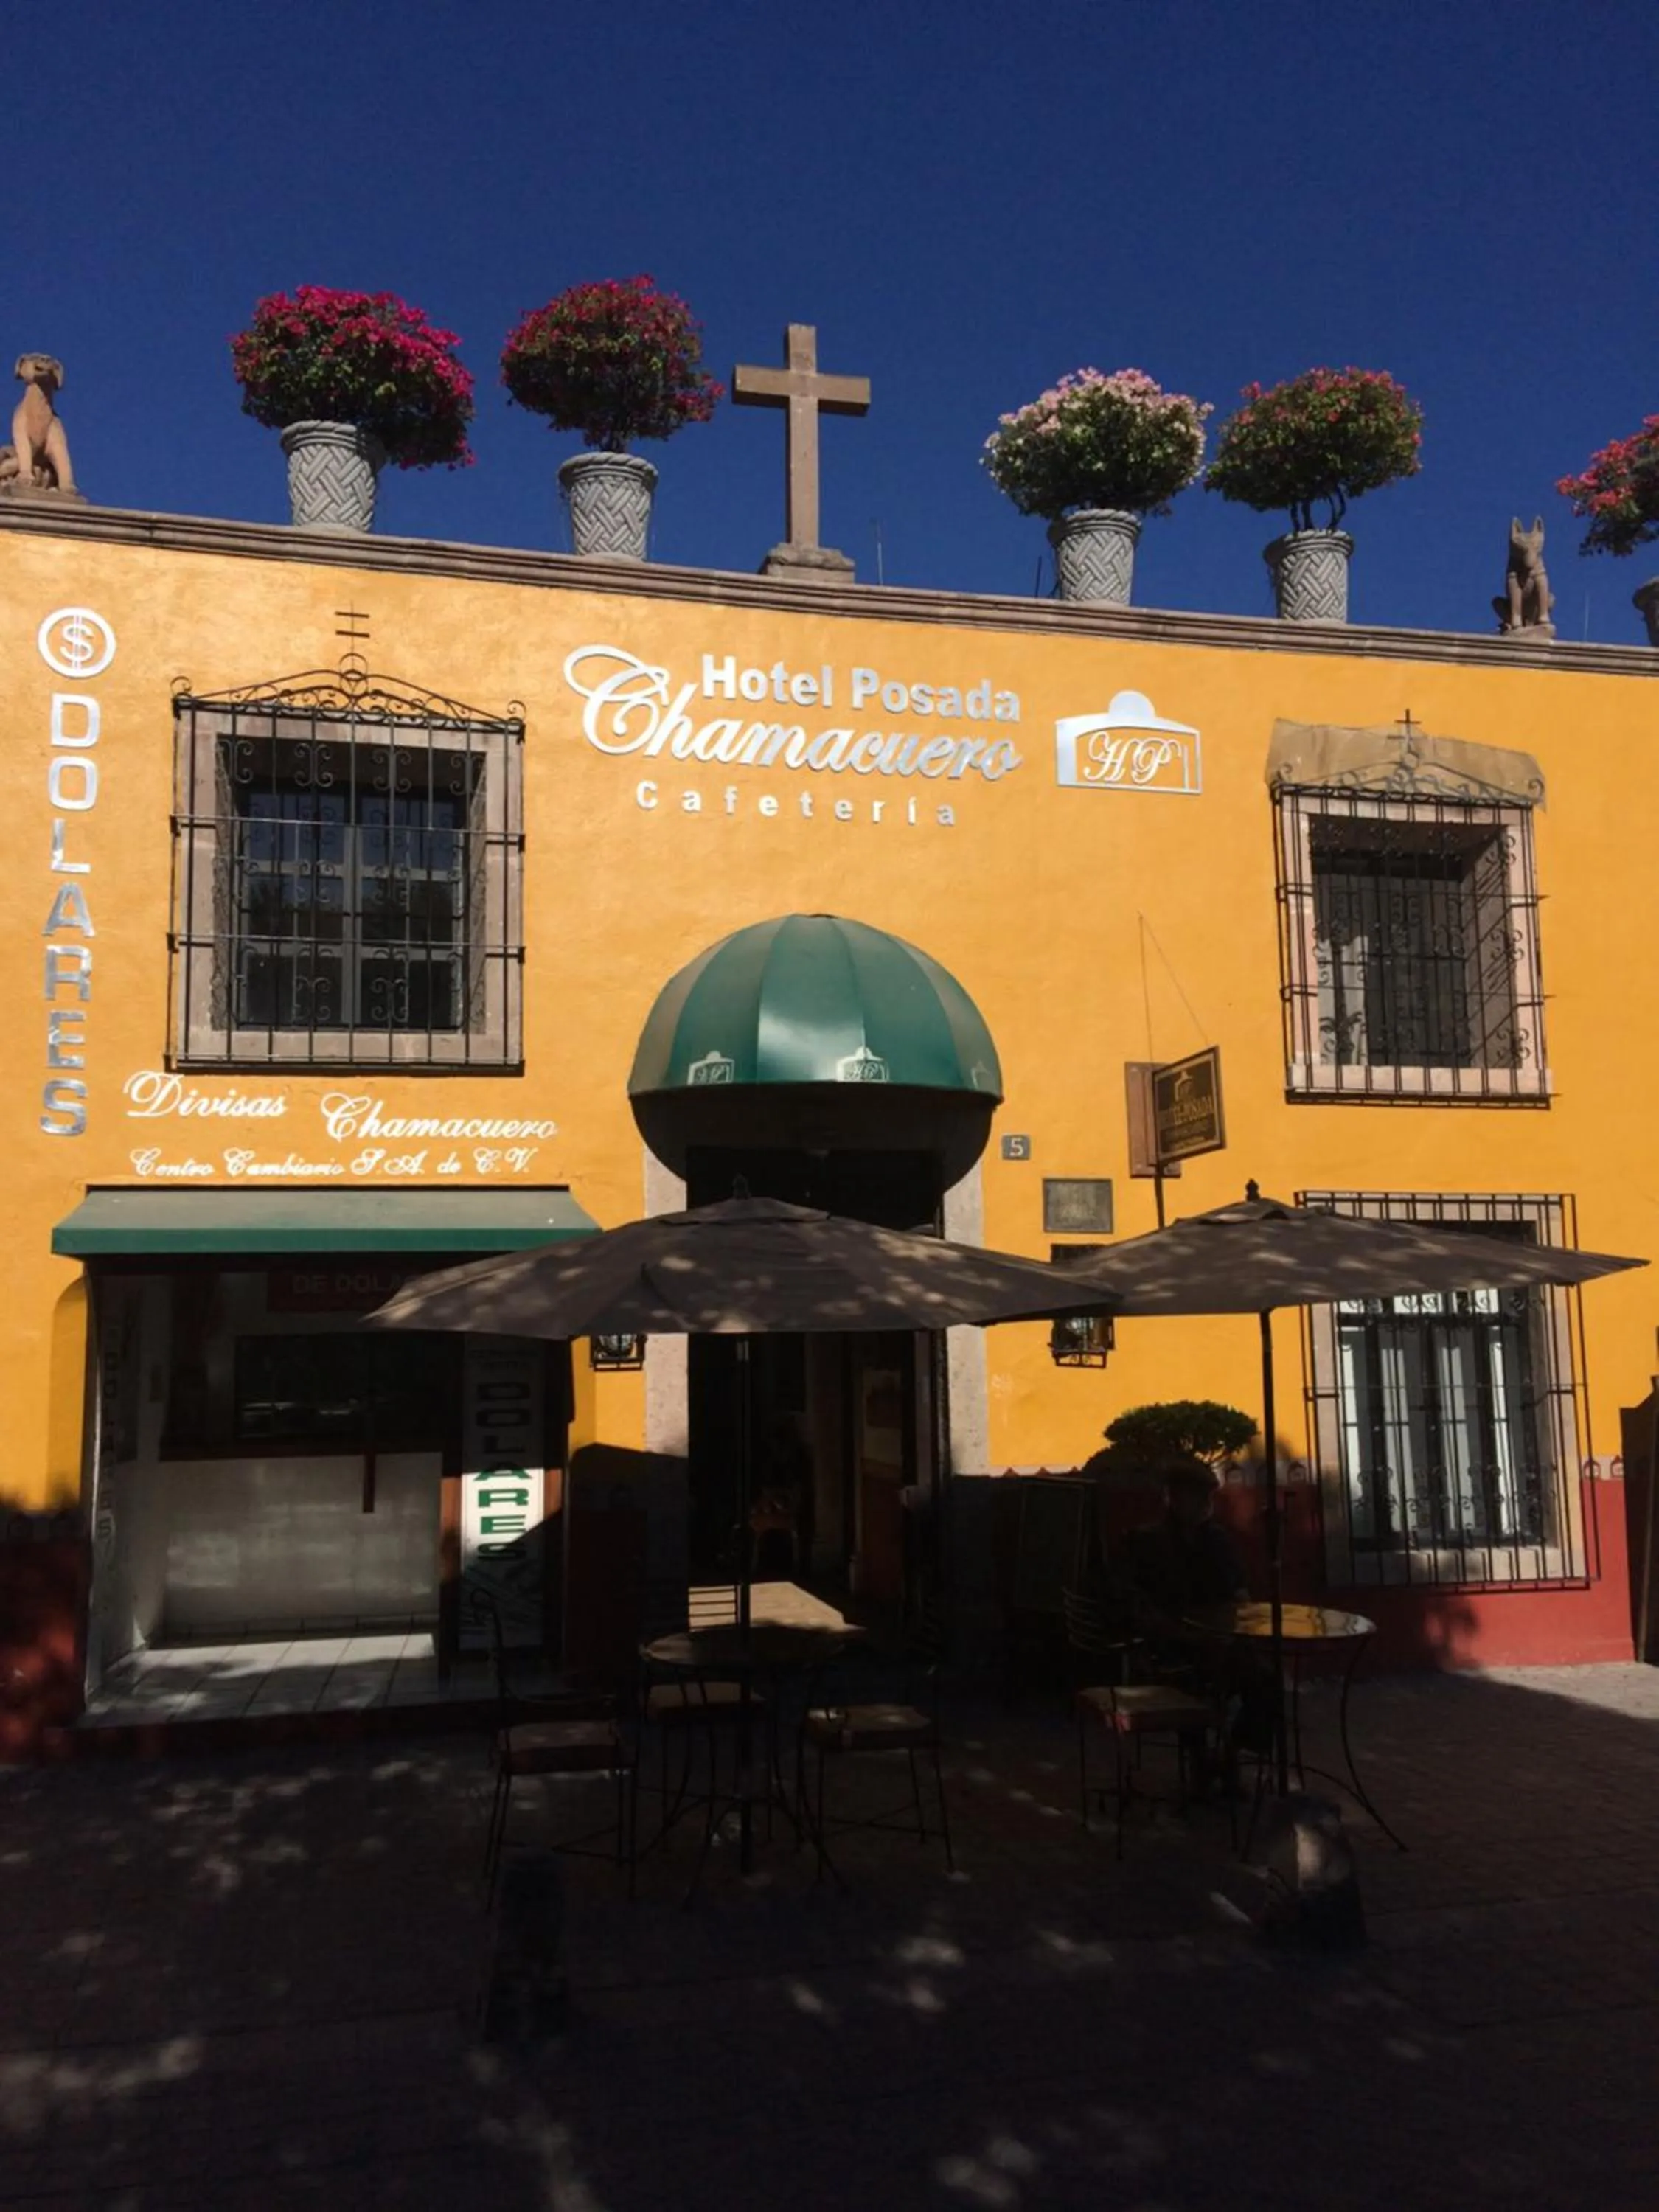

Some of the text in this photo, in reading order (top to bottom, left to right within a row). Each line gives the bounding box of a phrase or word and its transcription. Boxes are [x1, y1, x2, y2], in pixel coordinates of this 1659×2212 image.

[563, 644, 1023, 782] Chamacuero
[701, 653, 1022, 723] Hotel Posada
[1083, 731, 1183, 785] HP
[39, 692, 101, 1138] DOLARES
[123, 1071, 559, 1143] Divisas Chamacuero
[129, 1147, 216, 1177] Centro
[223, 1147, 346, 1176] Cambiario
[437, 1150, 462, 1175] de
[1009, 1137, 1025, 1158] 5
[292, 1273, 413, 1295] DE DOLA
[473, 1381, 532, 1562] DOLARES
